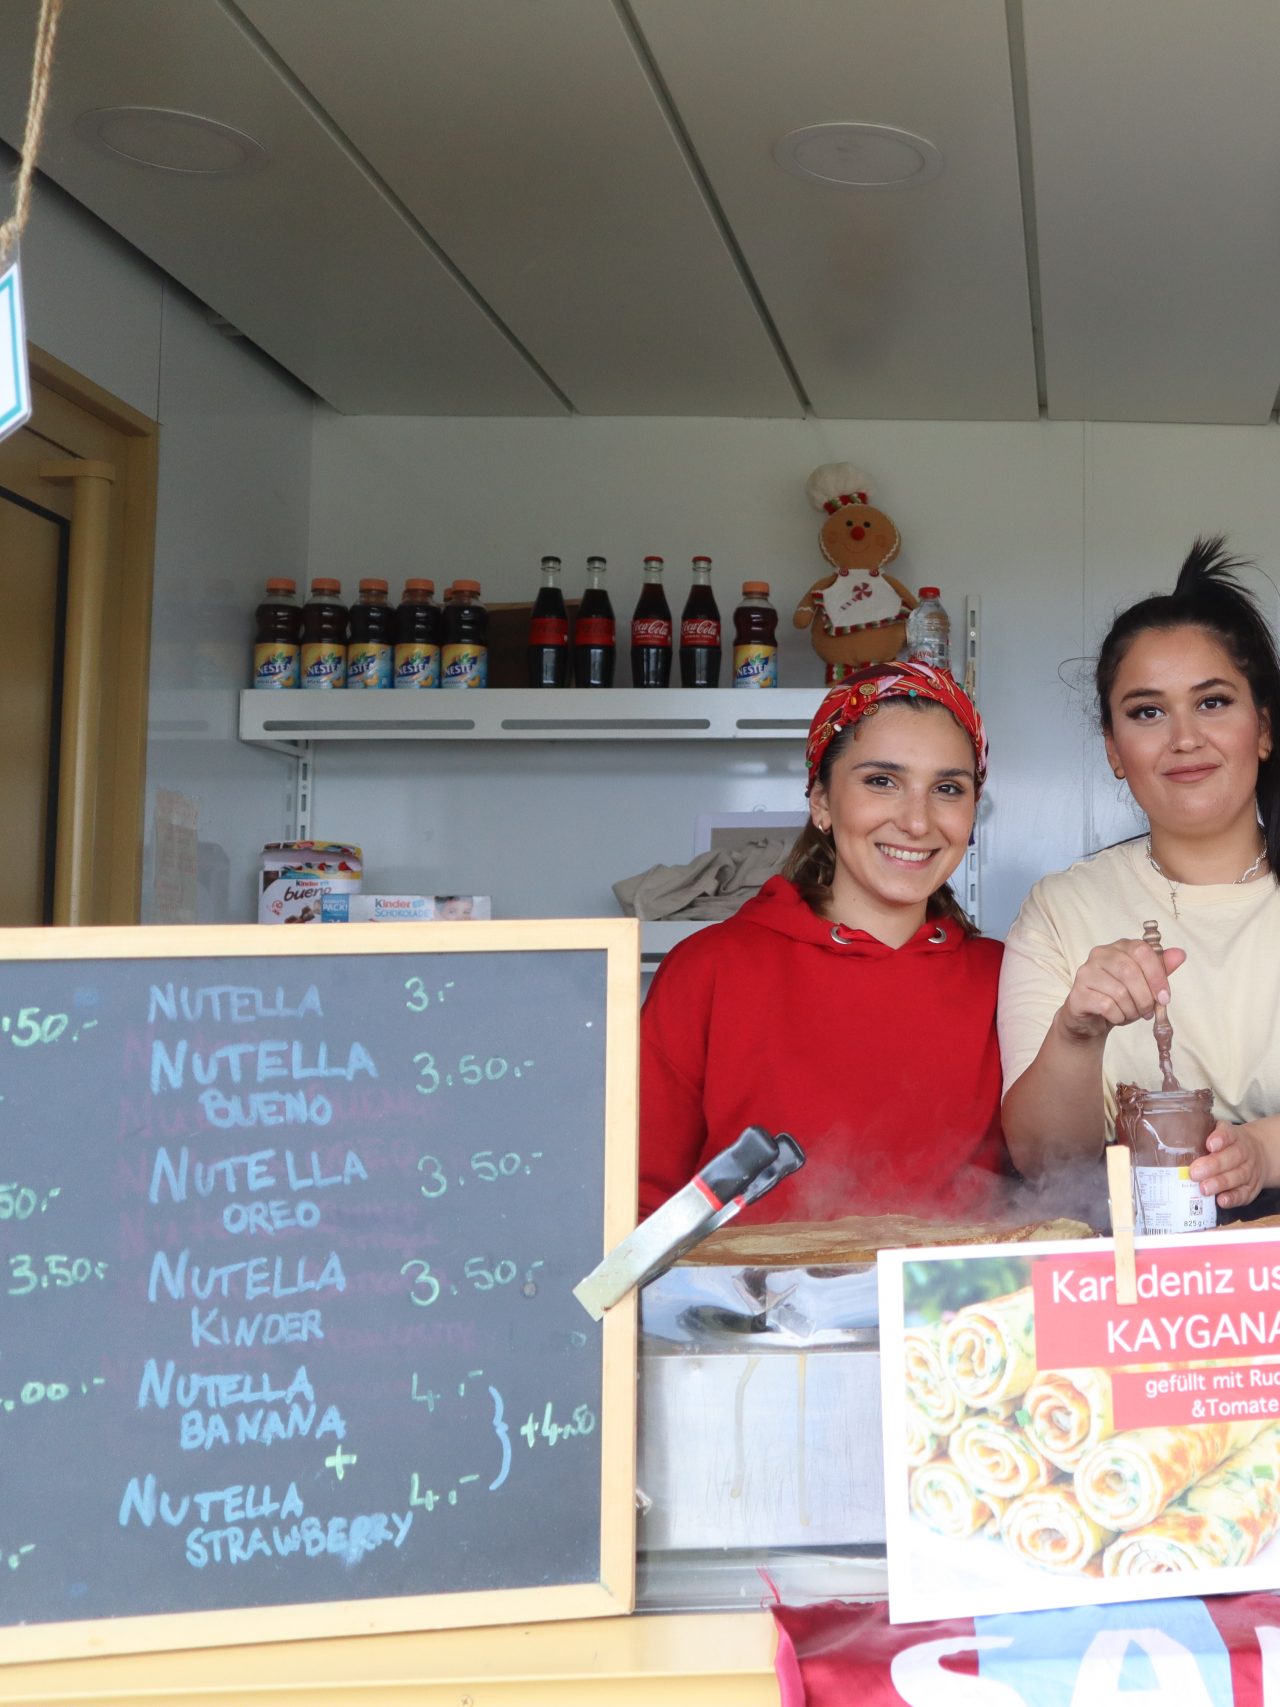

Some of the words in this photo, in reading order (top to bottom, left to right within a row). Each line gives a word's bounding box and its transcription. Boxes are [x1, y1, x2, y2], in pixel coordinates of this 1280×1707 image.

[258, 663, 293, 675] NESTEA
[736, 663, 771, 679] NESTEA
[283, 886, 332, 902] bueno
[374, 899, 411, 909] Kinder
[148, 982, 324, 1024] NUTELLA
[150, 1039, 380, 1096] NUTELLA
[198, 1087, 334, 1129] BUENO
[149, 1146, 368, 1205] NUTELLA
[222, 1199, 321, 1236] OREO
[148, 1248, 347, 1303] NUTELLA
[1052, 1262, 1235, 1304] Kardeniz
[191, 1305, 325, 1348] KINDER
[138, 1357, 315, 1410] NUTELLA
[1145, 1370, 1207, 1398] gefüllt
[1213, 1369, 1244, 1390] mit
[180, 1402, 347, 1450] BANANA
[1191, 1397, 1280, 1418] &Tomate
[118, 1473, 304, 1527] NUTELLA
[185, 1511, 414, 1569] STRAWBERRY
